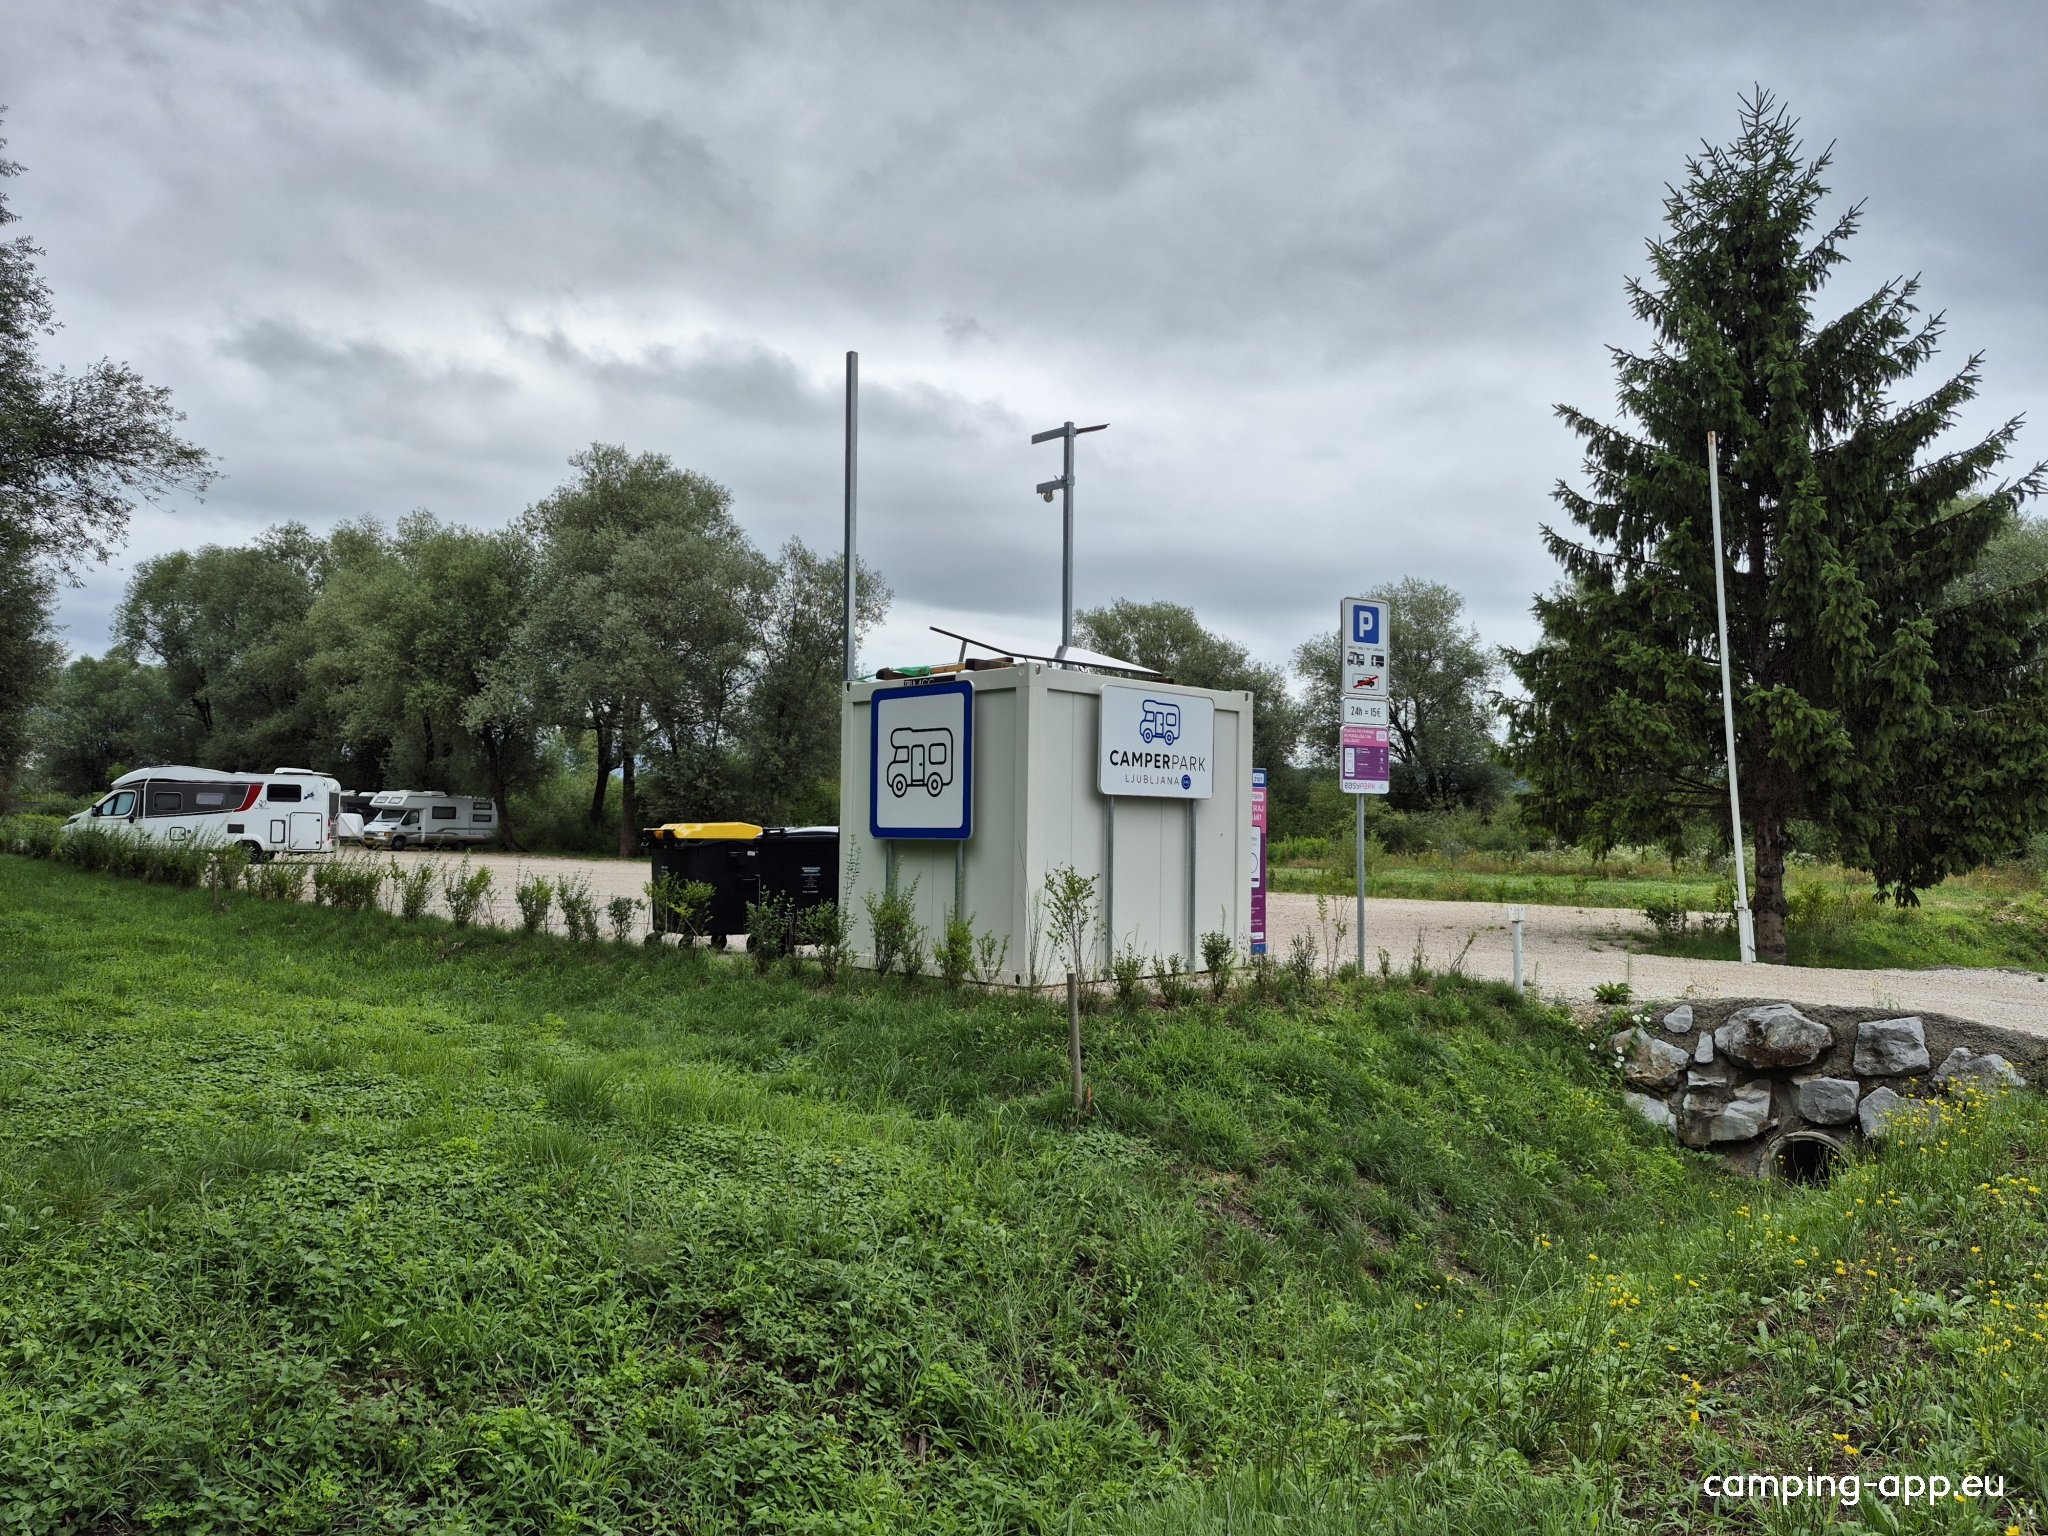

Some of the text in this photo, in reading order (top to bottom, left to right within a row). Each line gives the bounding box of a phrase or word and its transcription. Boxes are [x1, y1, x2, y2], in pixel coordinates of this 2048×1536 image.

[1359, 611, 1373, 638] P
[1351, 705, 1363, 716] 24h
[1370, 707, 1381, 718] 15€
[1109, 749, 1206, 772] CAMPERPARK
[1125, 774, 1179, 786] LJUBLJANA
